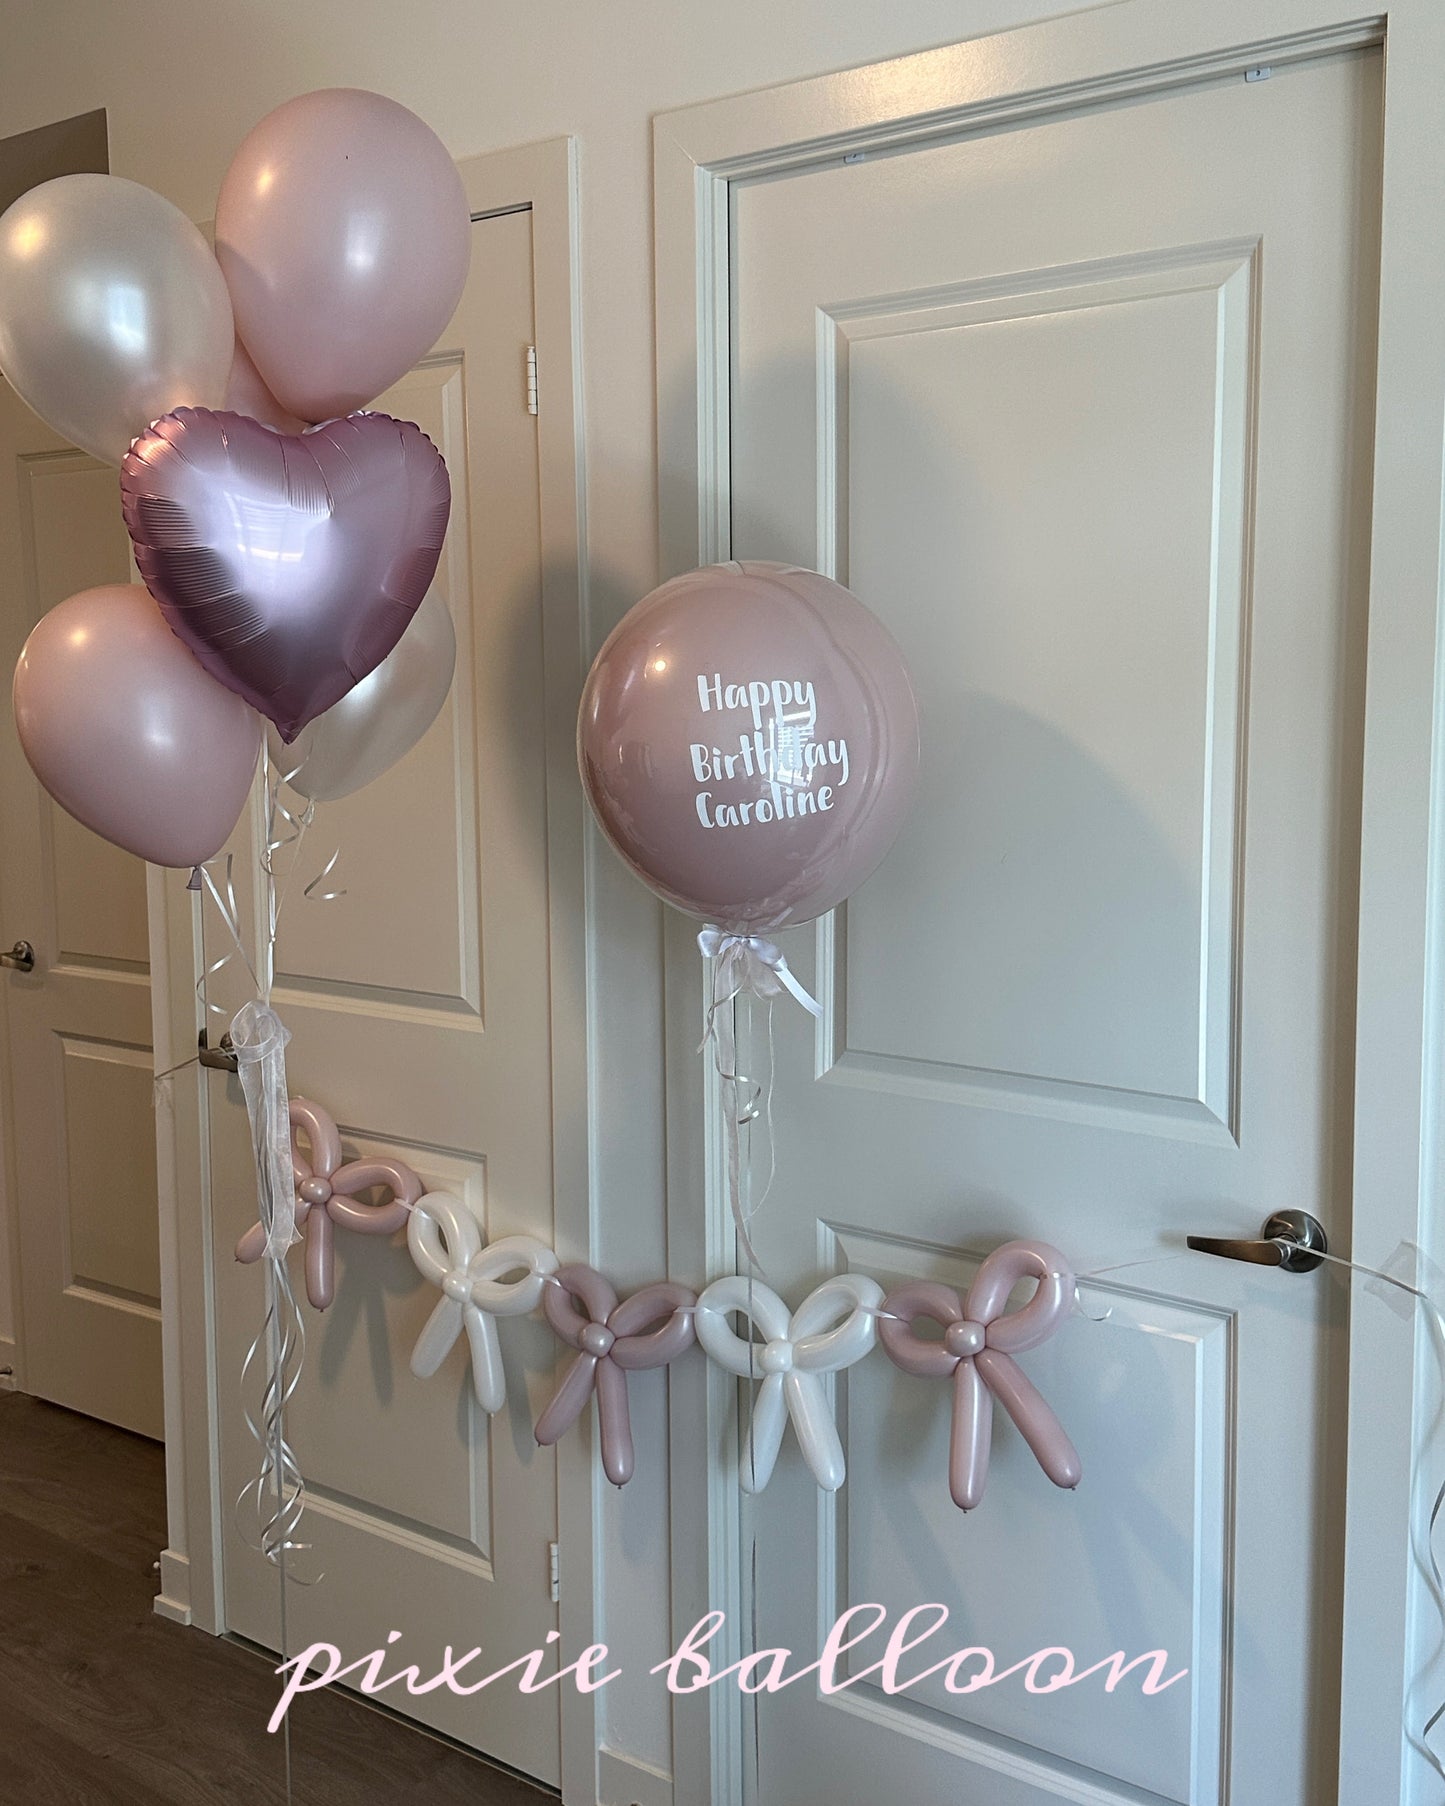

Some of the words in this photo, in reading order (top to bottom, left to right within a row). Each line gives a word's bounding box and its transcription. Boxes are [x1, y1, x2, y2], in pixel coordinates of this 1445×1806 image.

[697, 673, 817, 730] Happy
[689, 728, 849, 786] Birthday
[695, 781, 834, 828] Caroline
